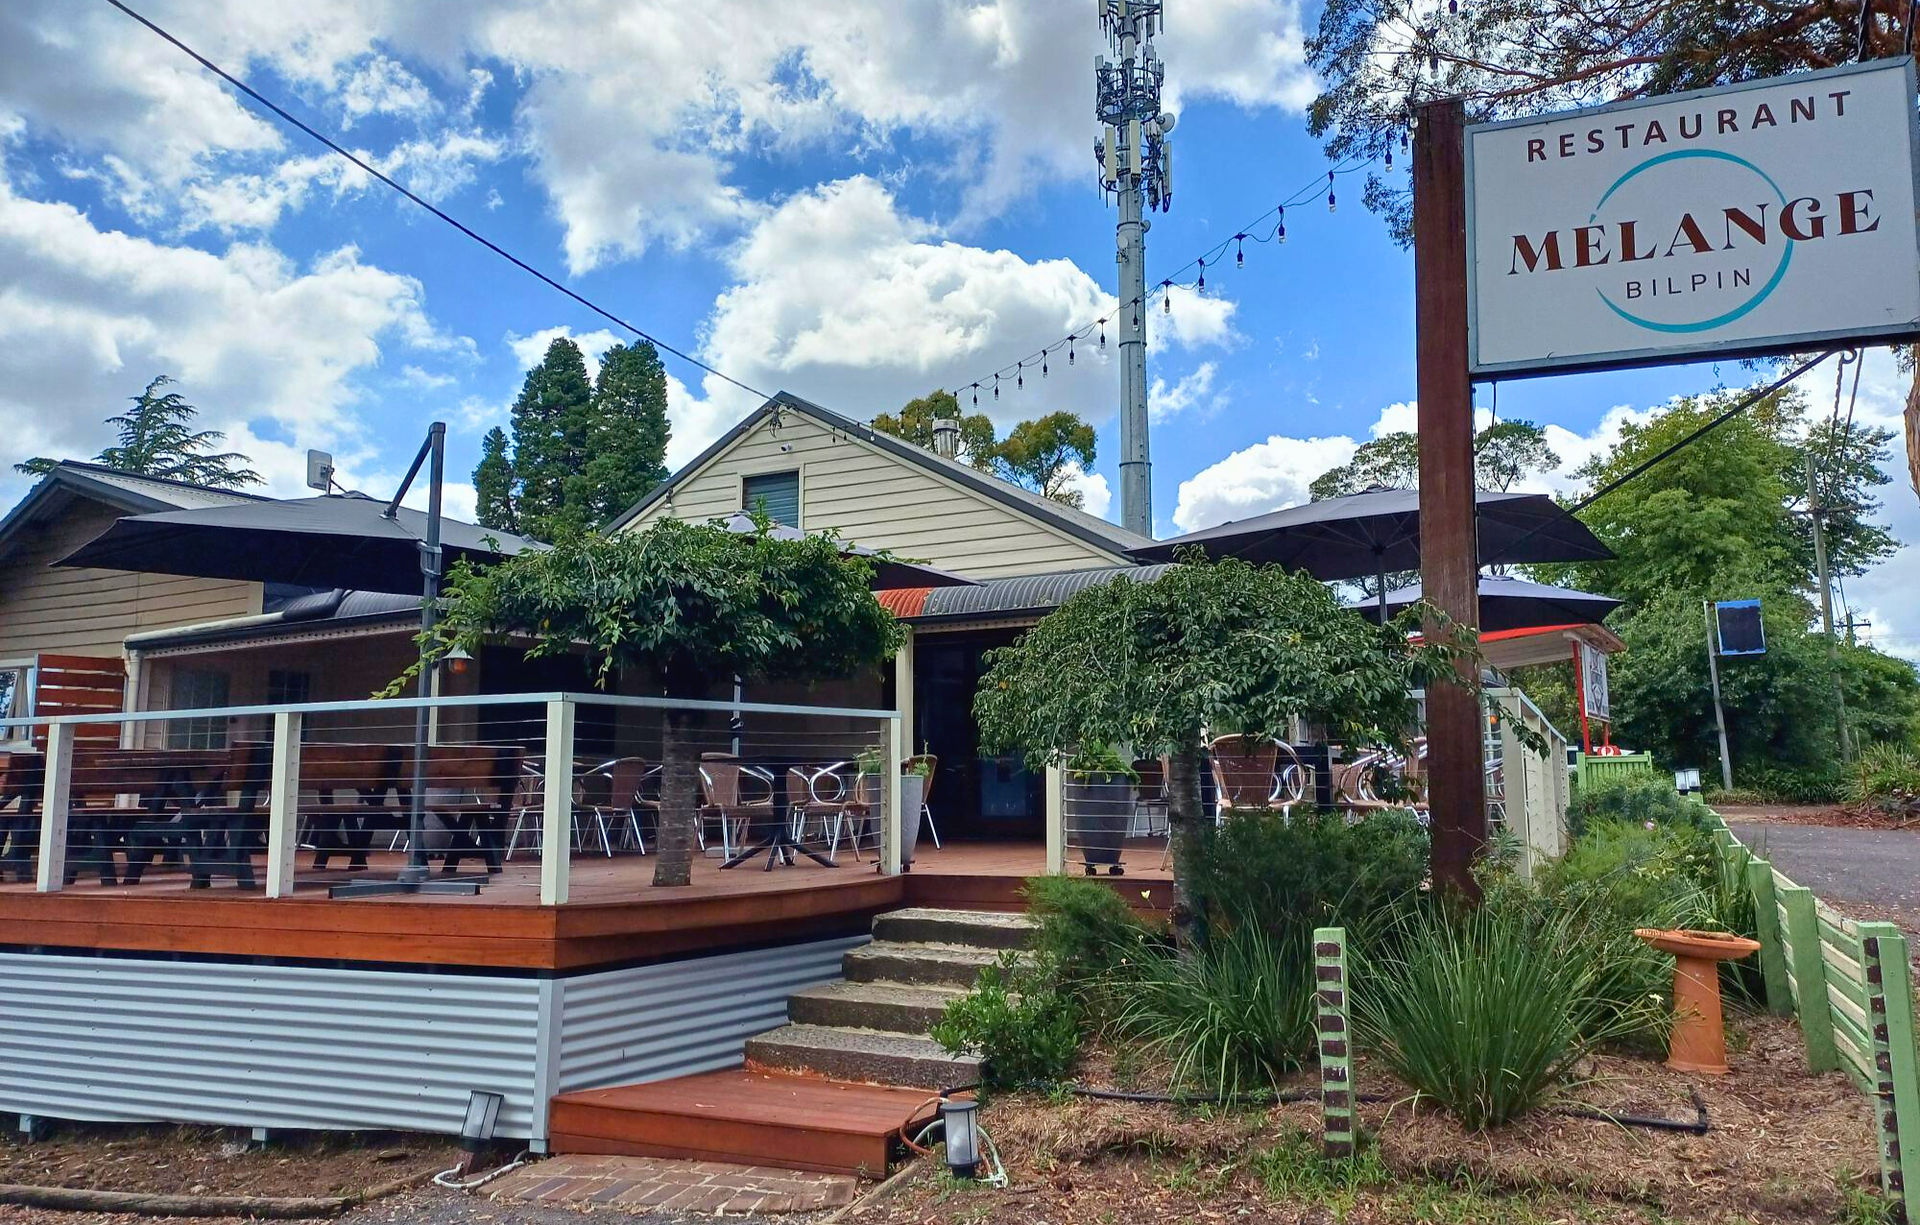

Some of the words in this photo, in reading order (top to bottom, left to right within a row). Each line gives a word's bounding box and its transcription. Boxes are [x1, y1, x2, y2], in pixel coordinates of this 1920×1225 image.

[1527, 91, 1852, 162] RESTAURANT
[1507, 189, 1881, 276] MÉLANGE
[1627, 268, 1752, 299] BILPIN
